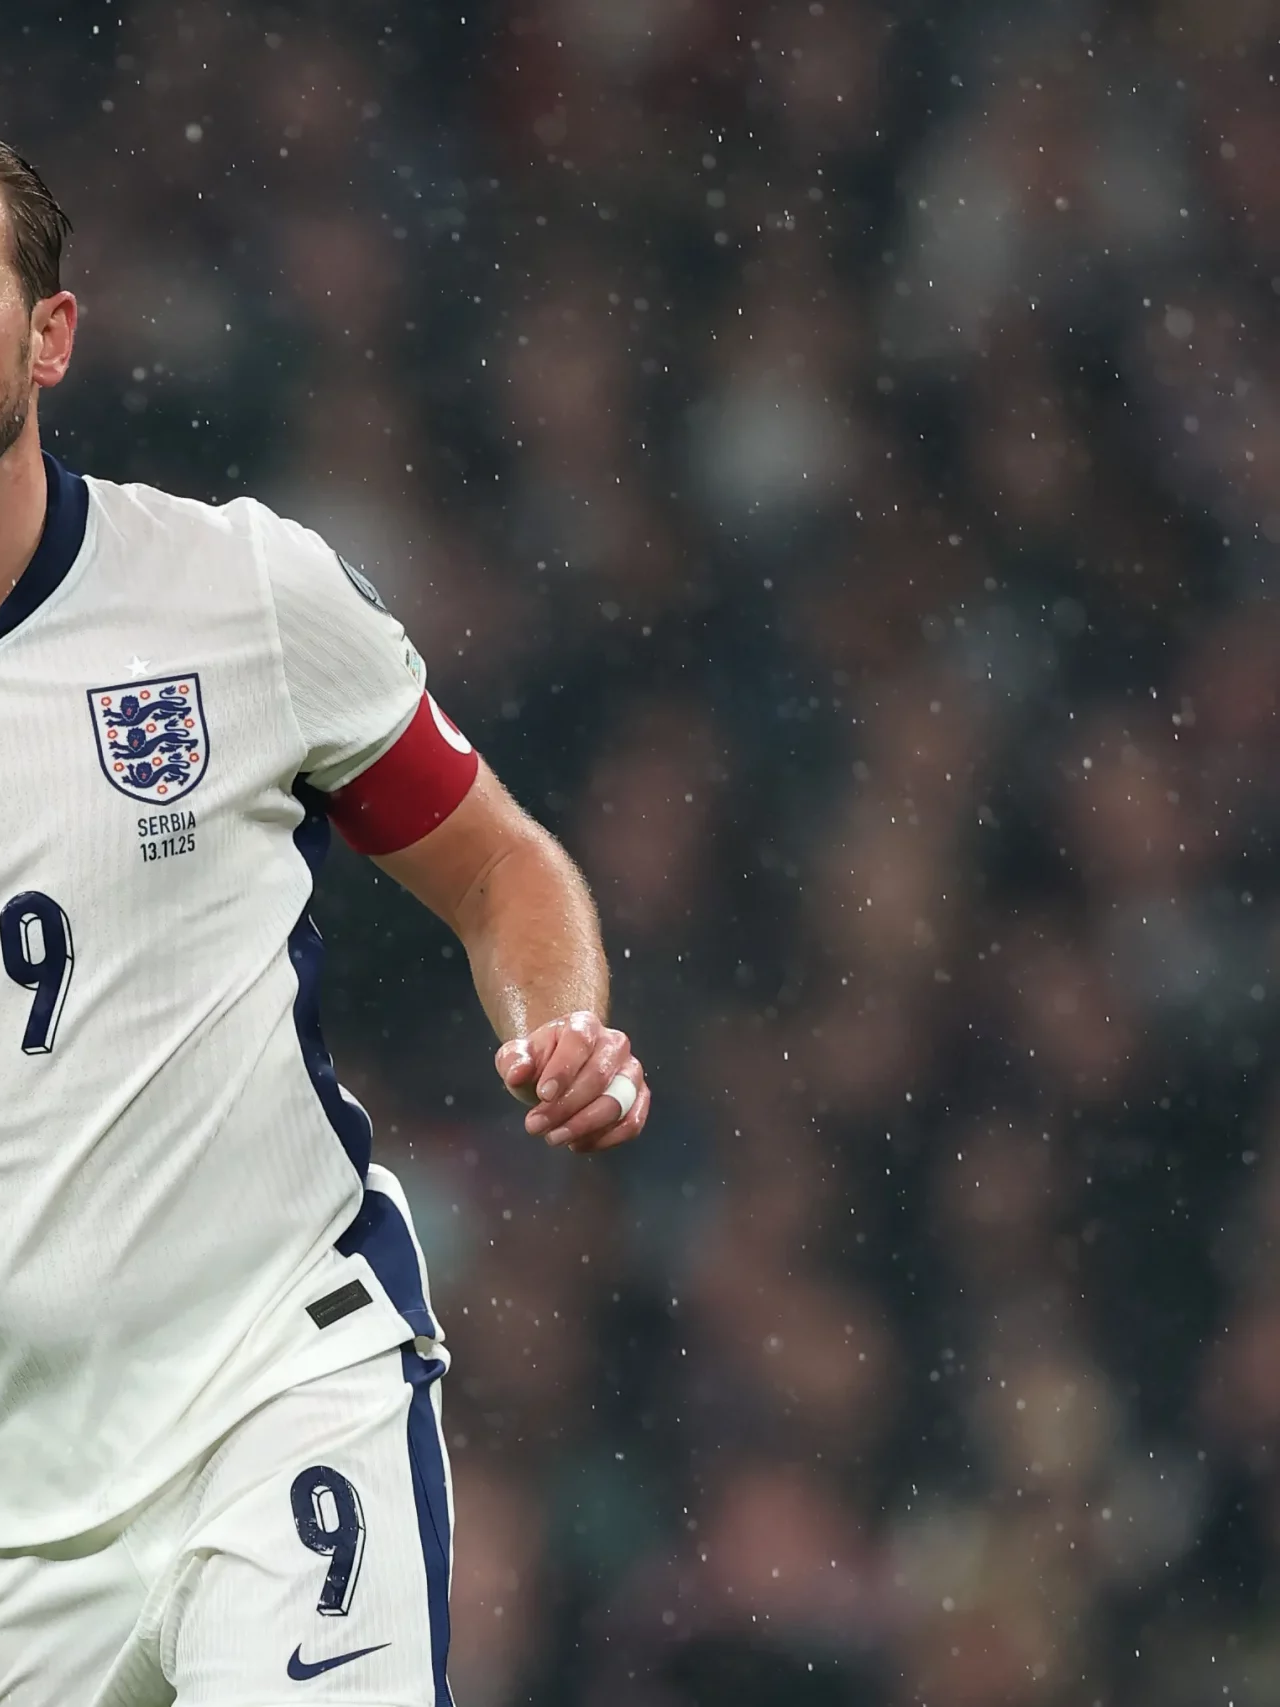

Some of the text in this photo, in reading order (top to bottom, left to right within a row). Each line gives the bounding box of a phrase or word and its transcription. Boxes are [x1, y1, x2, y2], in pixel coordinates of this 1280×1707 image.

[137, 810, 196, 837] SERBIA
[140, 833, 196, 862] 13.11.25
[290, 1465, 367, 1617] 9
